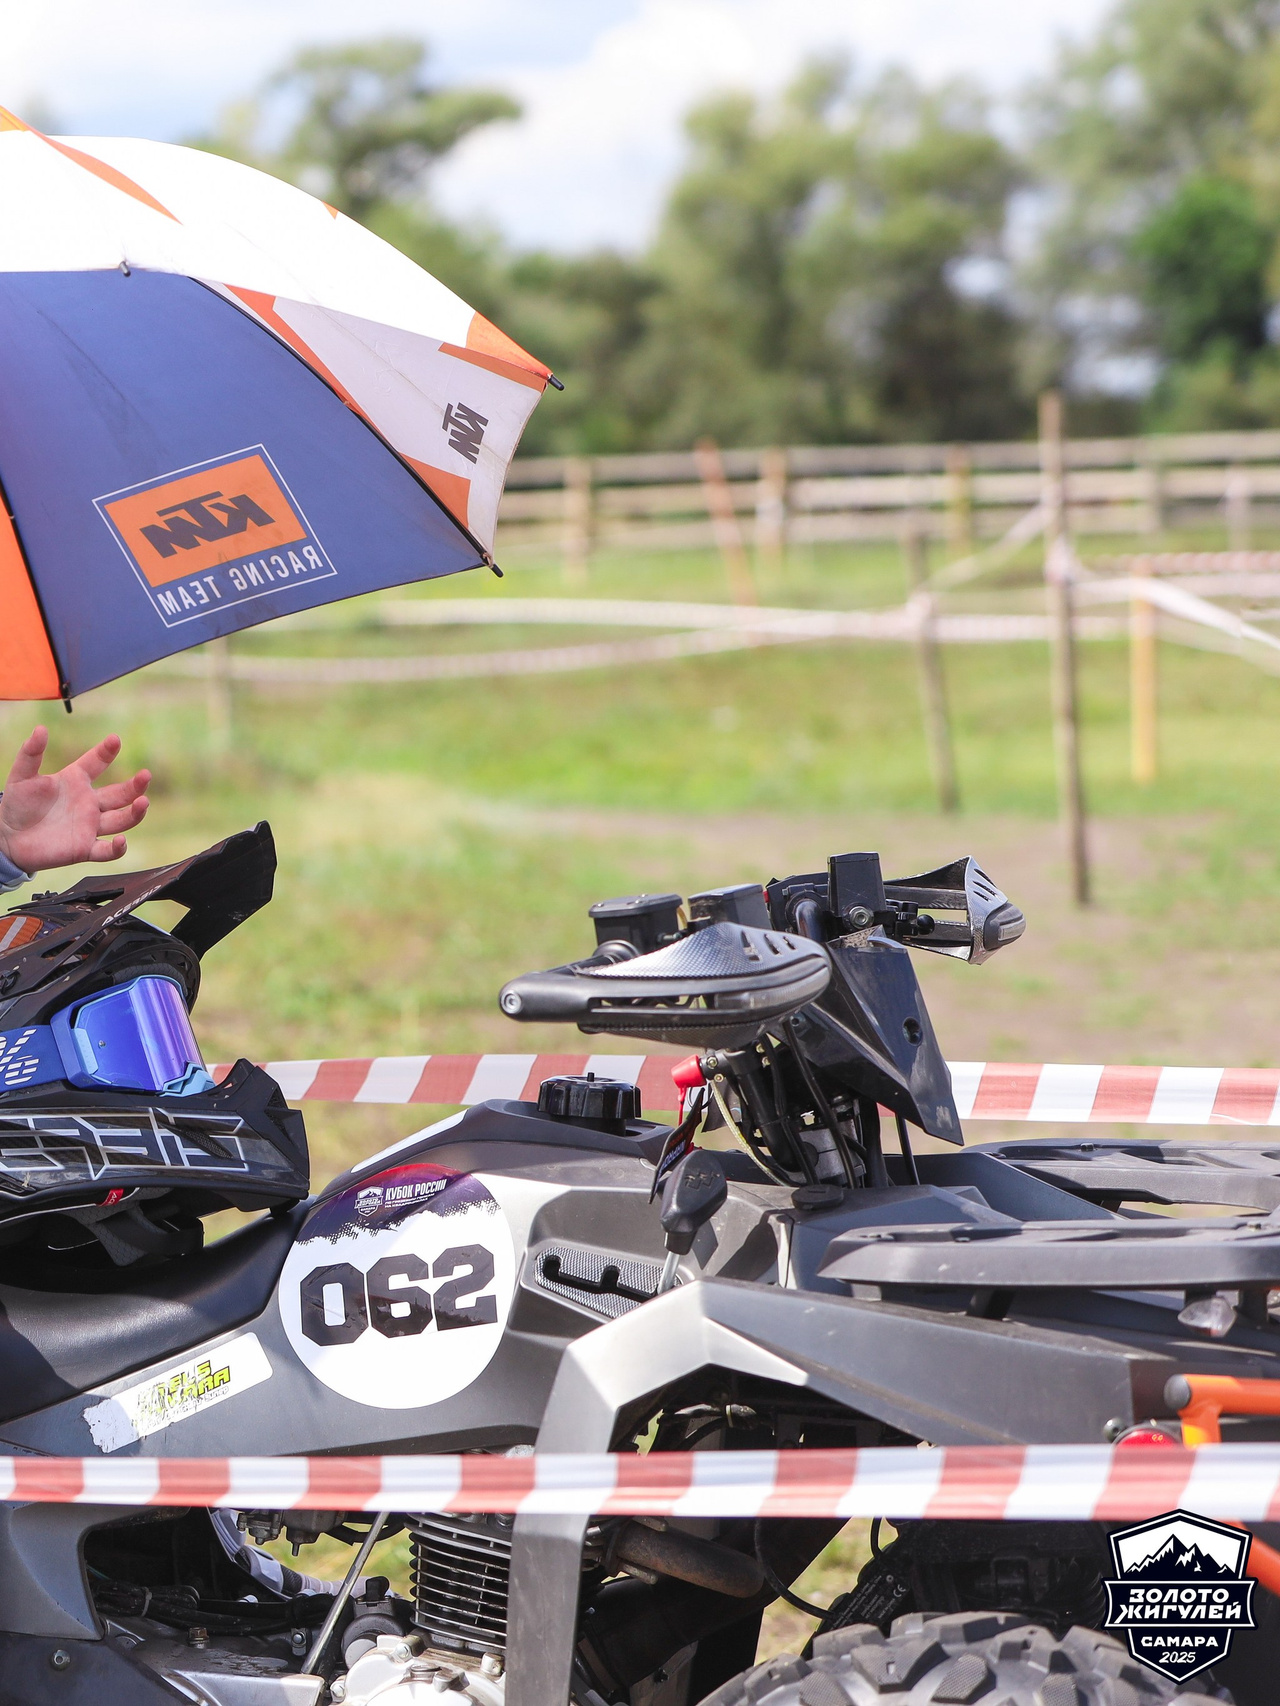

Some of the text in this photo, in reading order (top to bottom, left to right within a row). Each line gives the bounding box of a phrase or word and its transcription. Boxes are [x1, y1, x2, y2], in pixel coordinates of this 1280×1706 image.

[385, 1184, 413, 1201] КУБОК
[415, 1178, 448, 1197] РОССИИ
[299, 1243, 498, 1346] 062
